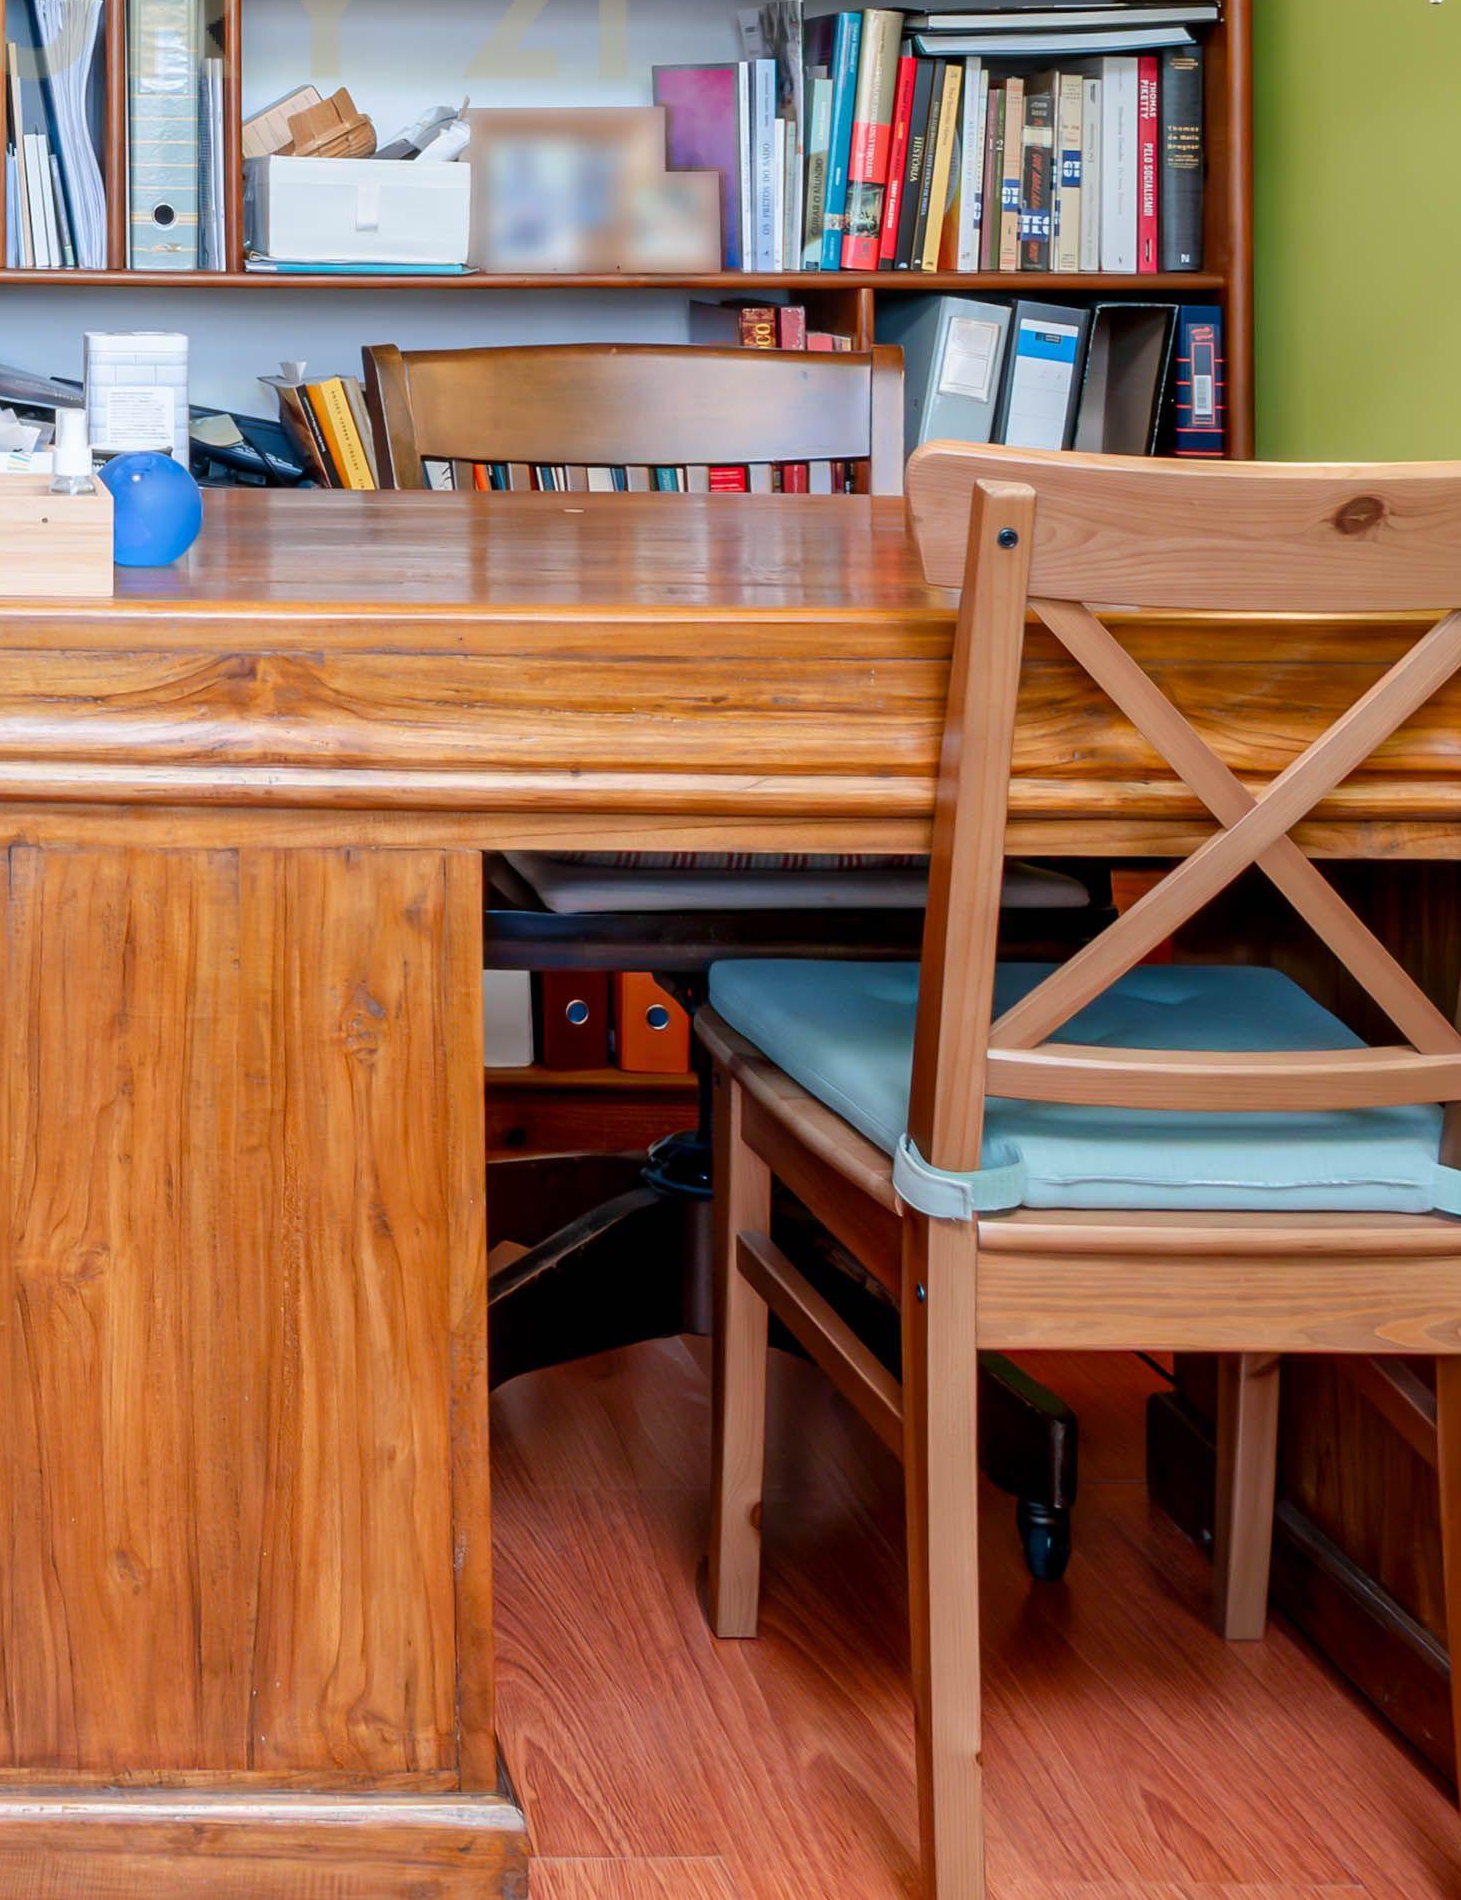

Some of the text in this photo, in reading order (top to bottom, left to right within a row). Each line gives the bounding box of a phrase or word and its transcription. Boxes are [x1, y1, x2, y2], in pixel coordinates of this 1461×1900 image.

[1140, 79, 1150, 120] PIKETTY
[1148, 81, 1158, 118] THOMAS
[909, 136, 924, 182] HISTÓRIA
[995, 139, 1004, 151] 2
[1143, 142, 1154, 164] PELO
